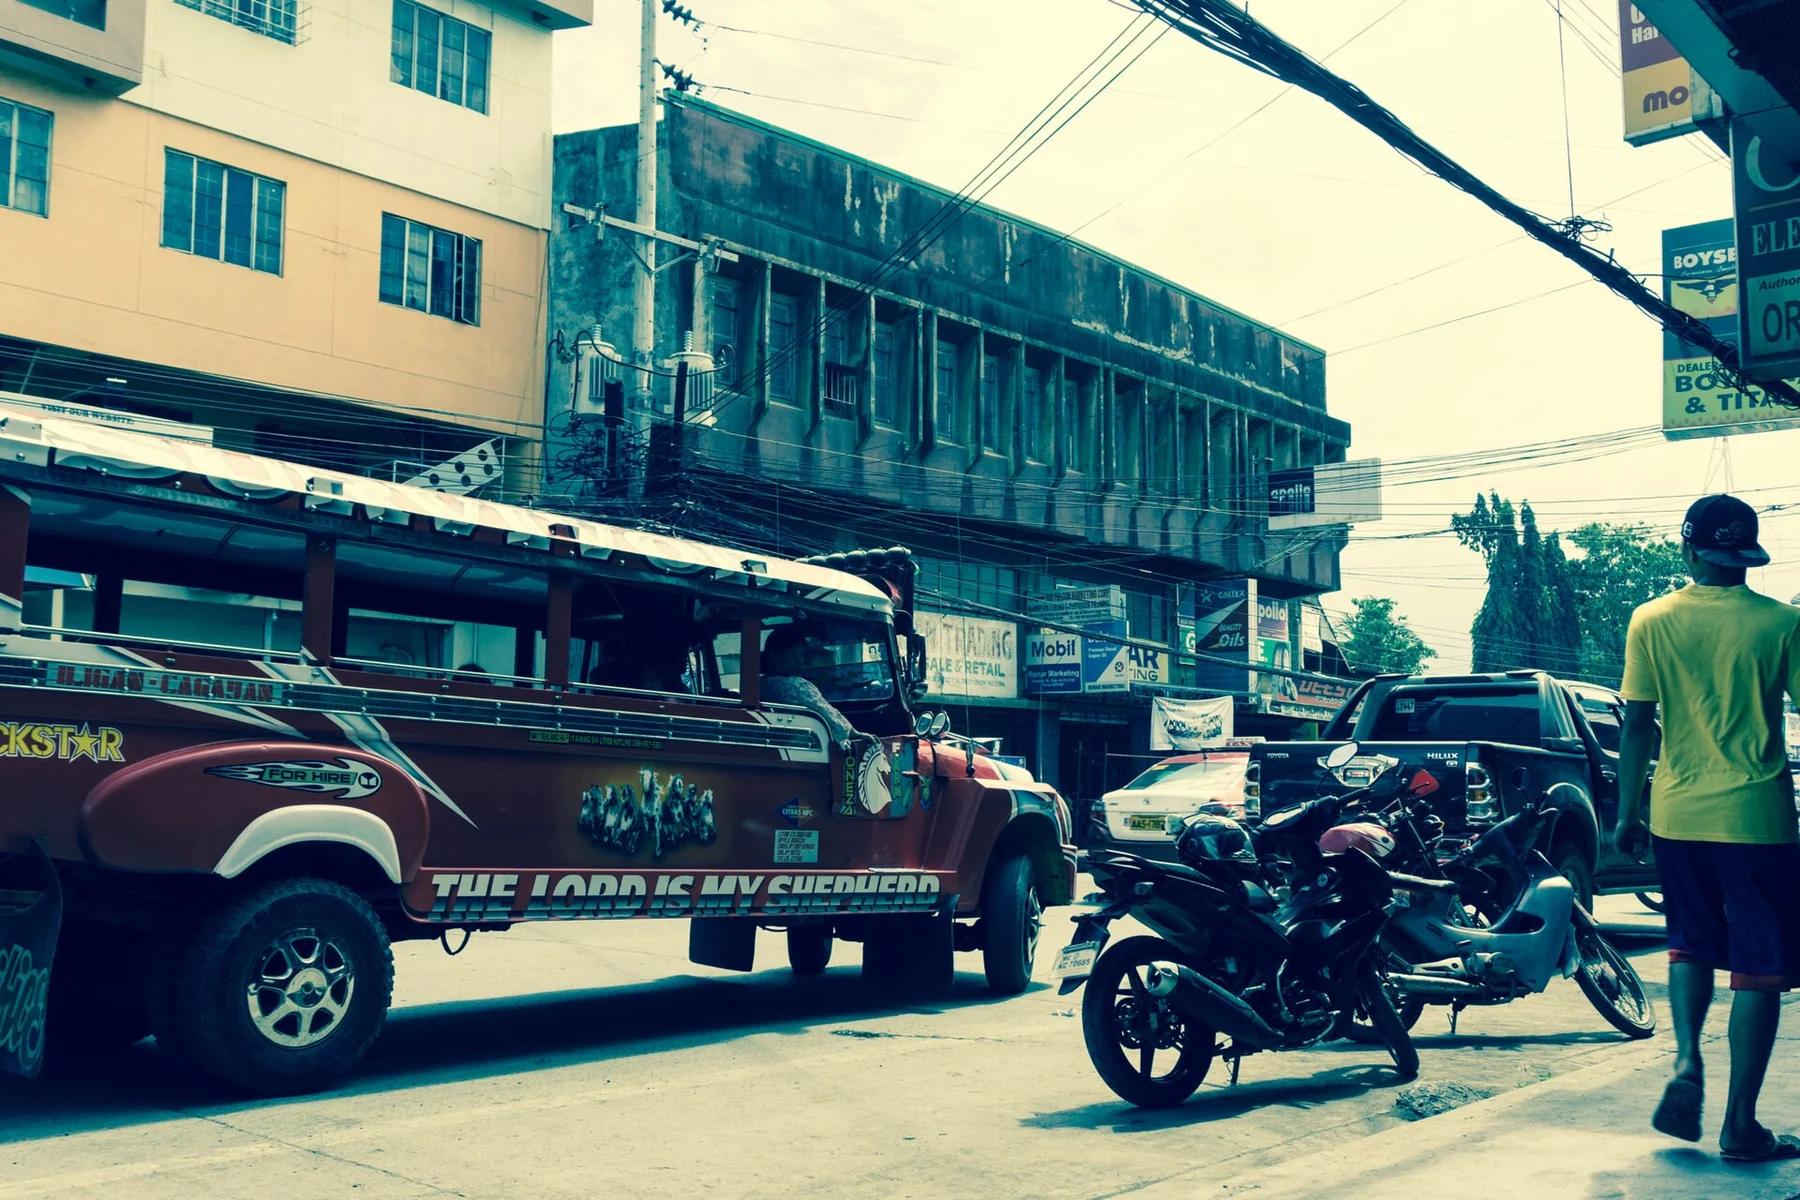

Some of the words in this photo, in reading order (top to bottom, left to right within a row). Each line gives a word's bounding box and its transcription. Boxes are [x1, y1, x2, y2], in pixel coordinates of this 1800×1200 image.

[40, 403, 66, 414] VISIT
[68, 406, 89, 418] OUR
[1684, 396, 1707, 414] &
[1217, 589, 1246, 599] CALTEX
[1219, 632, 1245, 648] Oils
[1031, 640, 1076, 658] Mobil
[964, 660, 1006, 678] RETAIL
[1266, 752, 1290, 760] TOYOTA
[1426, 752, 1459, 760] HILUX
[268, 767, 309, 781] FOR
[311, 769, 354, 784] HIRE
[428, 873, 519, 920] THE
[523, 873, 647, 920] LORD
[647, 874, 695, 918] IS
[692, 874, 765, 916] MY
[763, 874, 941, 915] SHEPHERD
